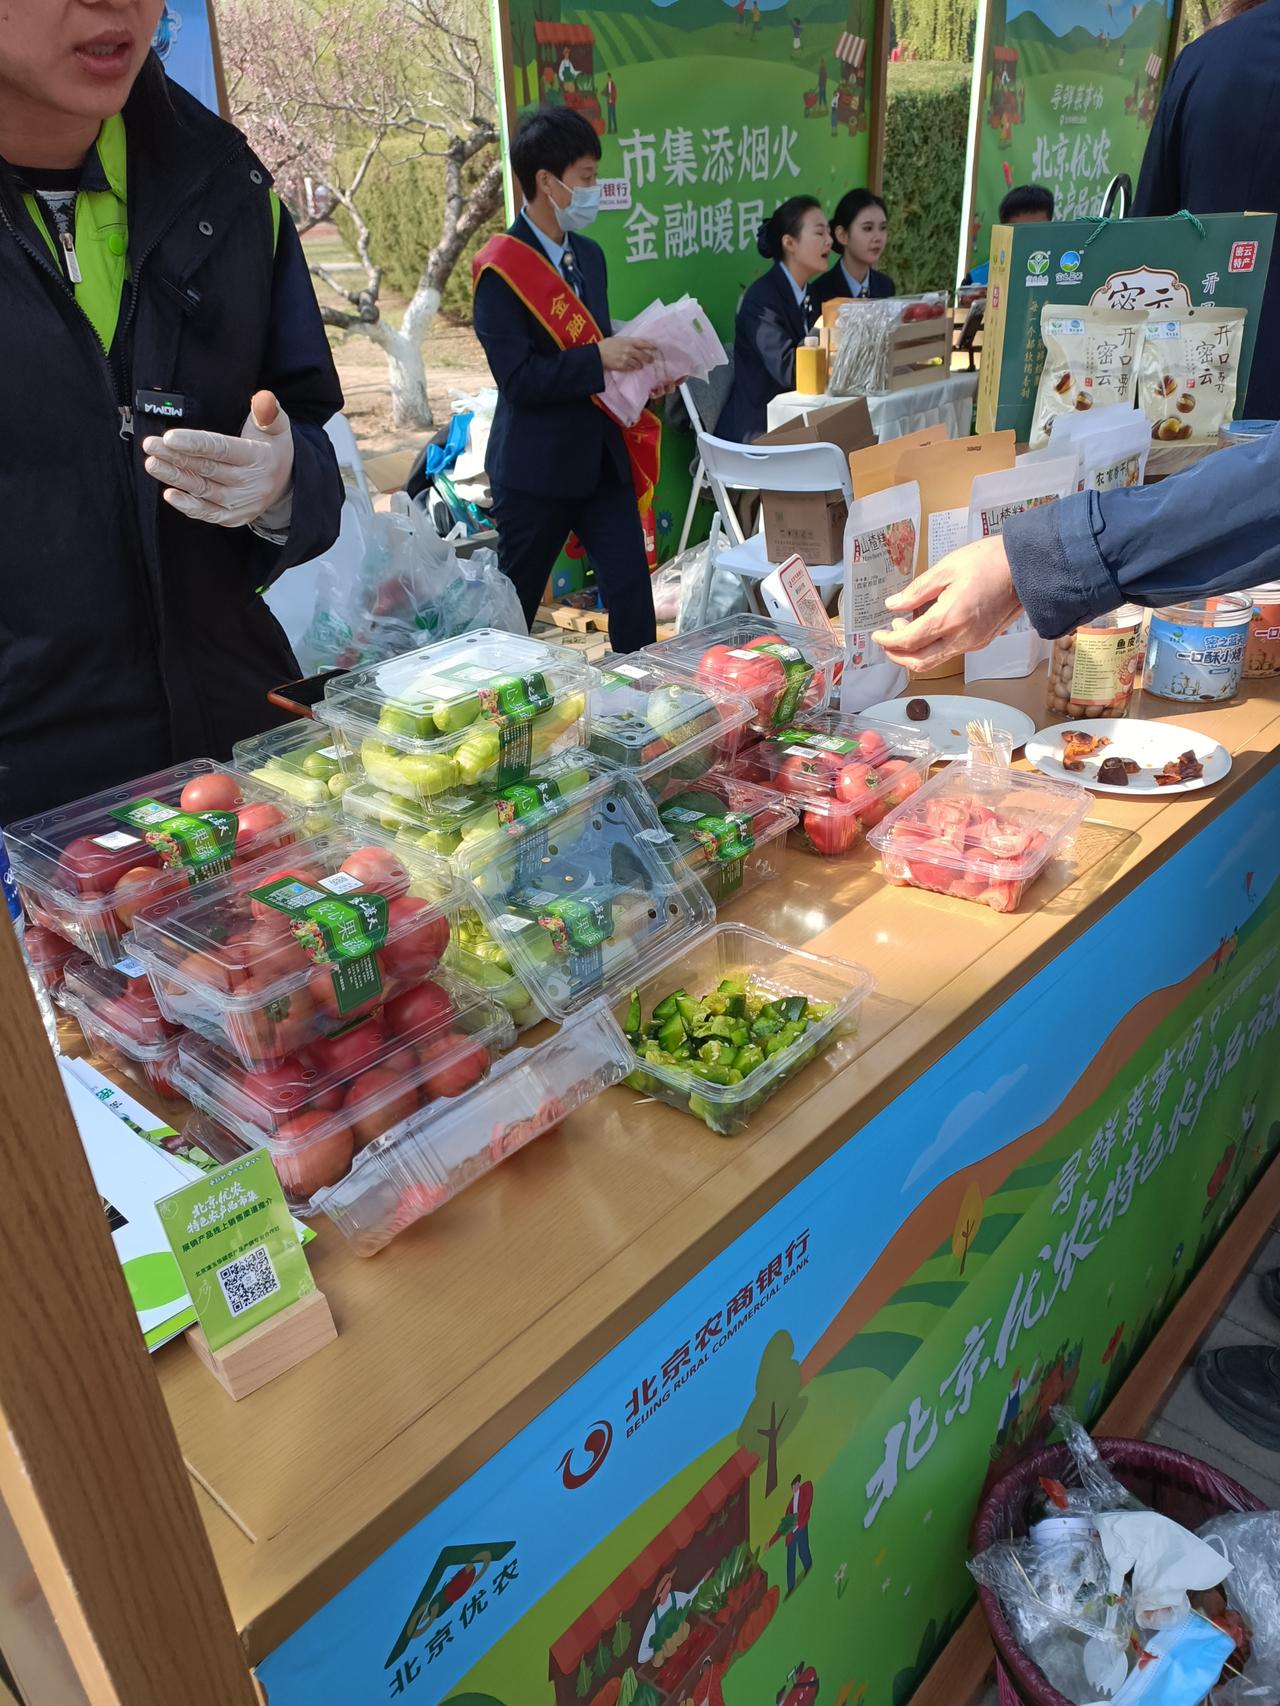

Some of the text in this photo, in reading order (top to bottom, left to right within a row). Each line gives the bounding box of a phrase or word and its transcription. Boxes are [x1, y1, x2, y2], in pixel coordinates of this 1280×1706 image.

[618, 125, 801, 188] 市集添烟火
[1032, 127, 1111, 182] 北京优农
[600, 182, 627, 197] 银行
[623, 197, 792, 264] 金融暖民
[1236, 246, 1253, 257] 密云
[1233, 258, 1251, 268] 特产
[549, 293, 600, 347] 金融
[1108, 281, 1174, 310] 密云
[1095, 341, 1118, 386] 密云
[1114, 327, 1136, 396] 开口栗
[1196, 341, 1216, 386] 密云
[144, 403, 183, 417] MOMA
[1176, 647, 1244, 666] 一口酥小烧
[1254, 627, 1280, 640] 一口
[314, 903, 368, 954] 安心果蔬
[1051, 1016, 1202, 1216] 寻鲜菜事场
[192, 1182, 245, 1217] 北京优农
[625, 1228, 810, 1423] 北京农商银行
[626, 1255, 810, 1438] BEIJING RURAL COMMERCIAL BANK
[863, 1190, 1102, 1528] 北京优农
[387, 1558, 520, 1698] 北京优农
